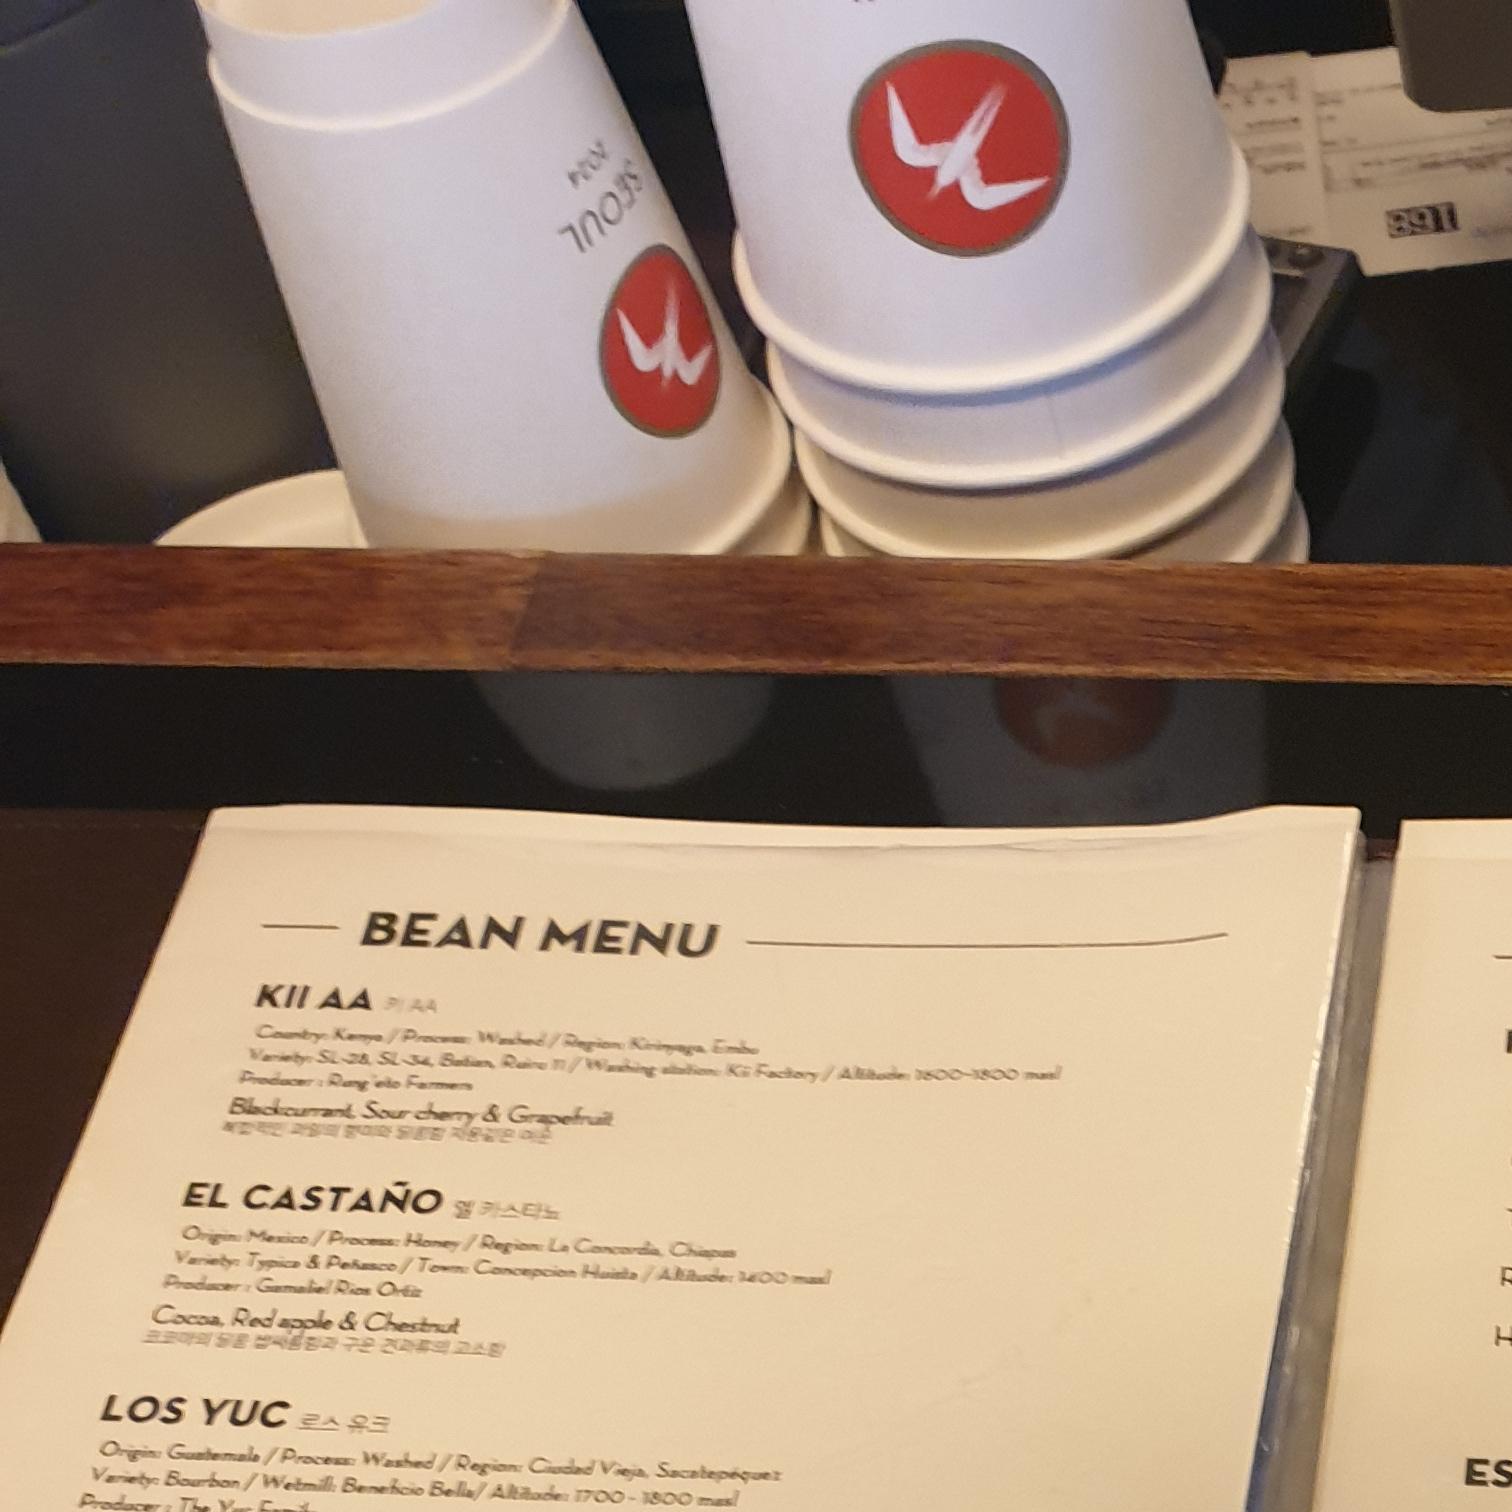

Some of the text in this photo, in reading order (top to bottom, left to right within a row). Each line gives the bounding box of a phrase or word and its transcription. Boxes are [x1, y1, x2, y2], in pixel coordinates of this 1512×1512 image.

[360, 912, 720, 958] BEAN MENU
[255, 984, 372, 1010] KII AA
[182, 1181, 443, 1214] EL CASTAÑO
[100, 1395, 291, 1428] LOS YUC
